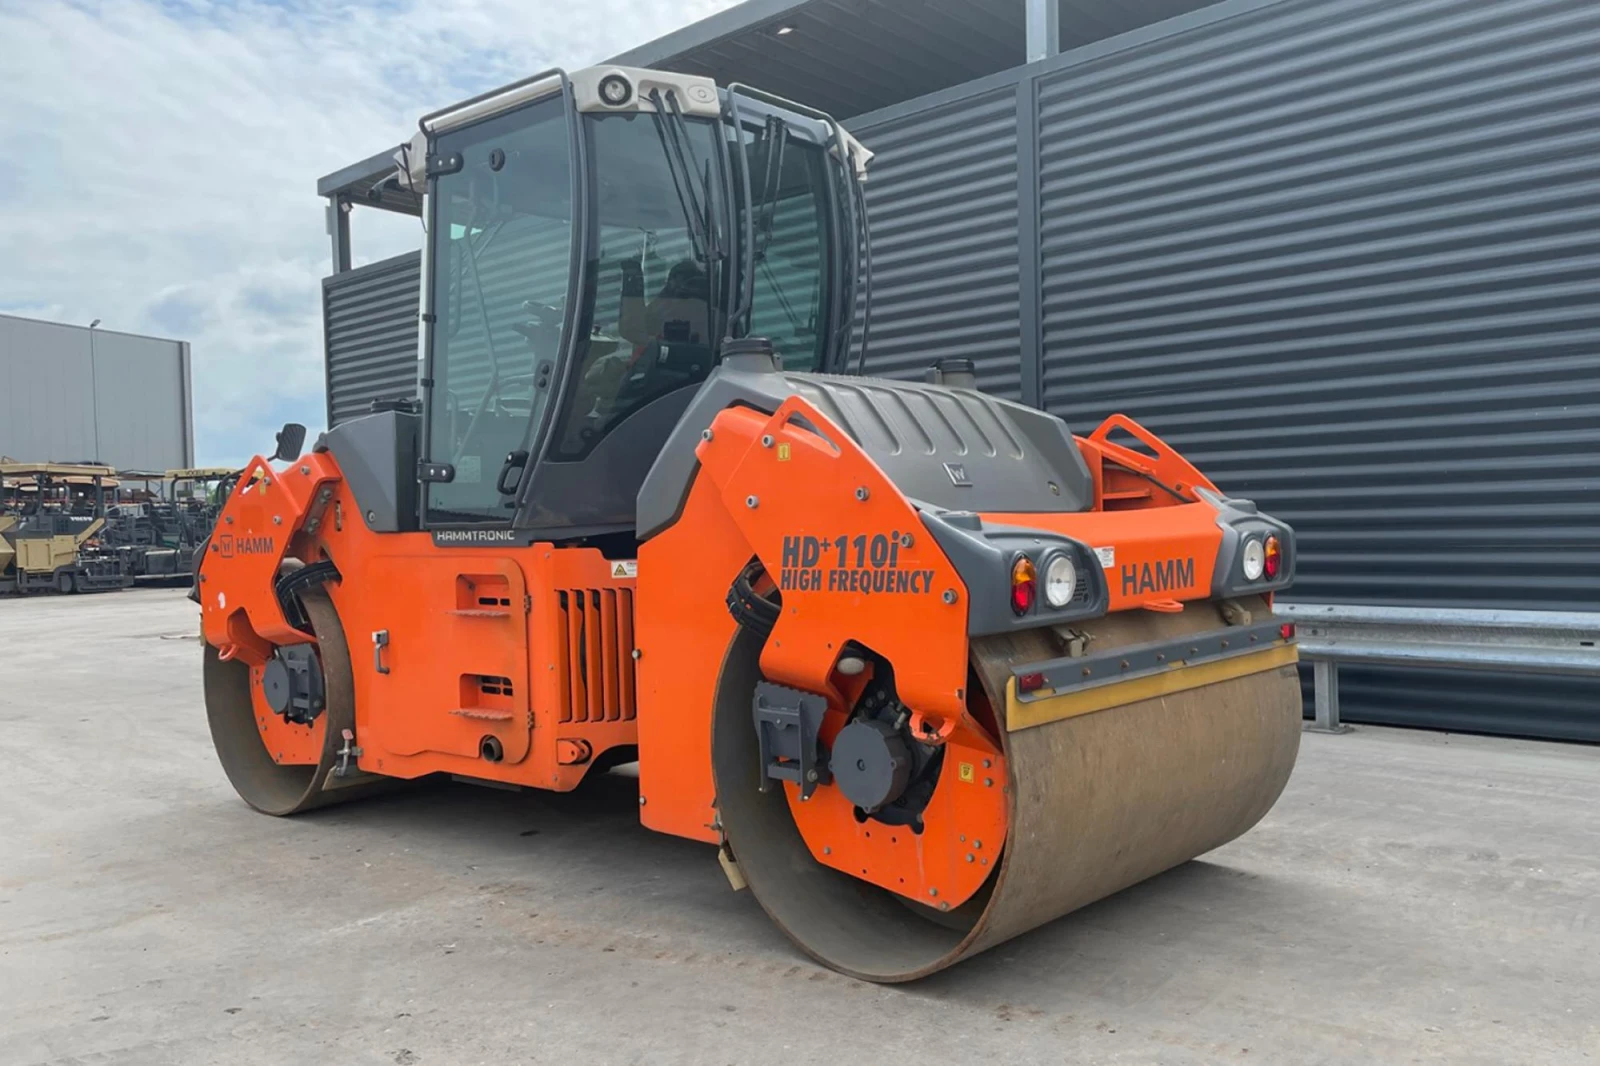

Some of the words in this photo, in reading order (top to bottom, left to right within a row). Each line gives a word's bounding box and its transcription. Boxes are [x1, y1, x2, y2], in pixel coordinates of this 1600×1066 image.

[236, 537, 273, 554] HAMM
[437, 530, 515, 541] HAMMTRONIC
[780, 569, 822, 591] HIGH
[828, 570, 935, 595] FREQUENCY
[1122, 557, 1194, 597] HAMM
